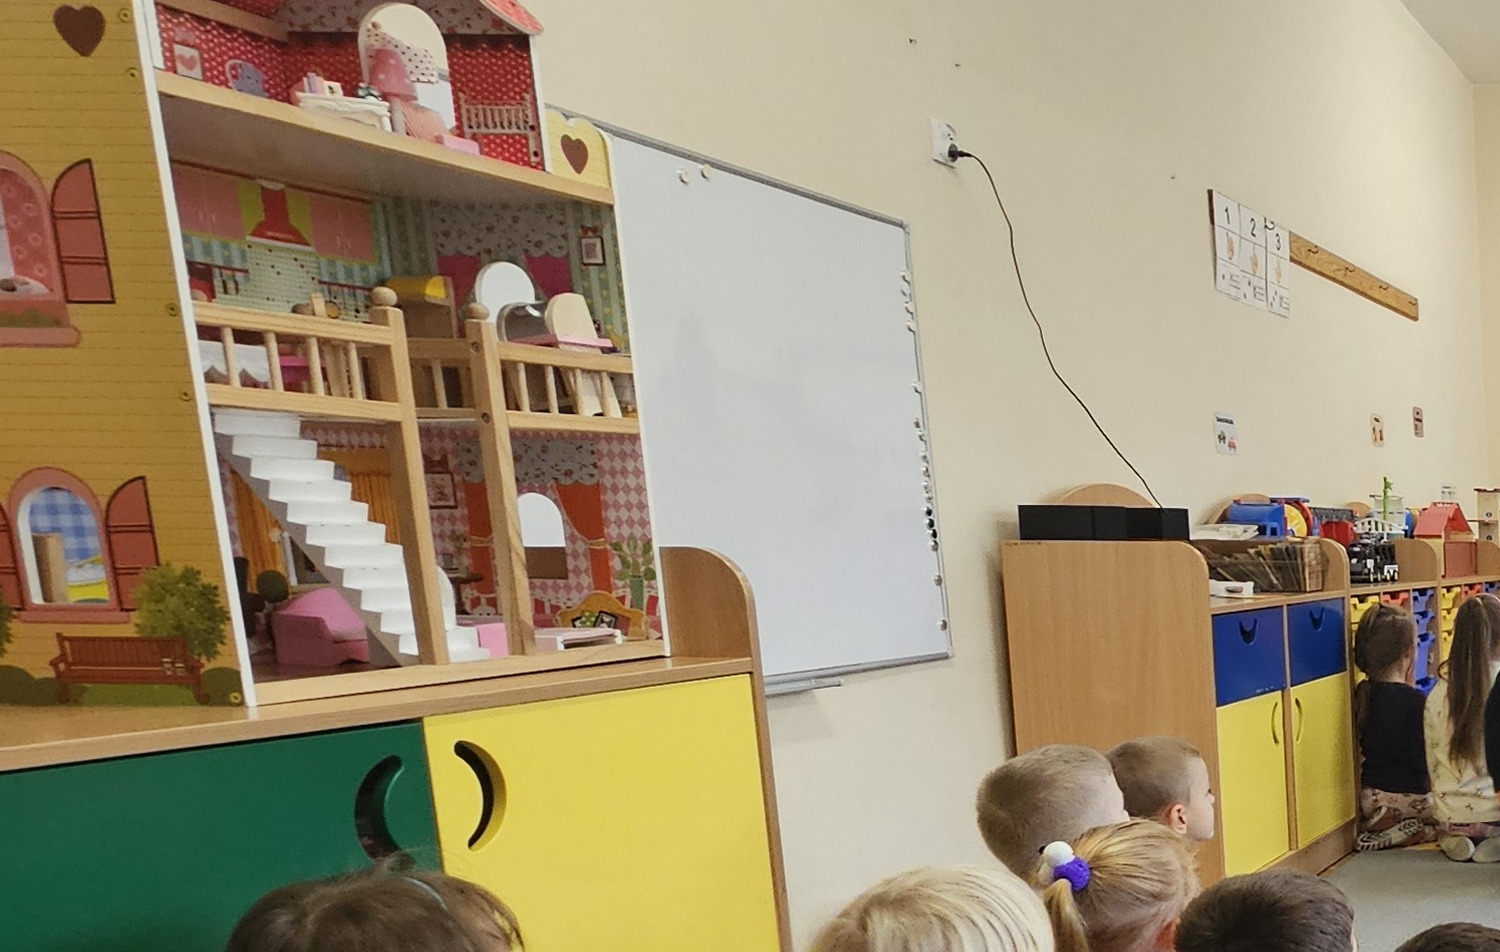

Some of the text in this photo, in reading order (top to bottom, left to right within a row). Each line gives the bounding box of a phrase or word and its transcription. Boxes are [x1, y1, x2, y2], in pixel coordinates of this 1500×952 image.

[1224, 206, 1282, 251] 1 2 3
